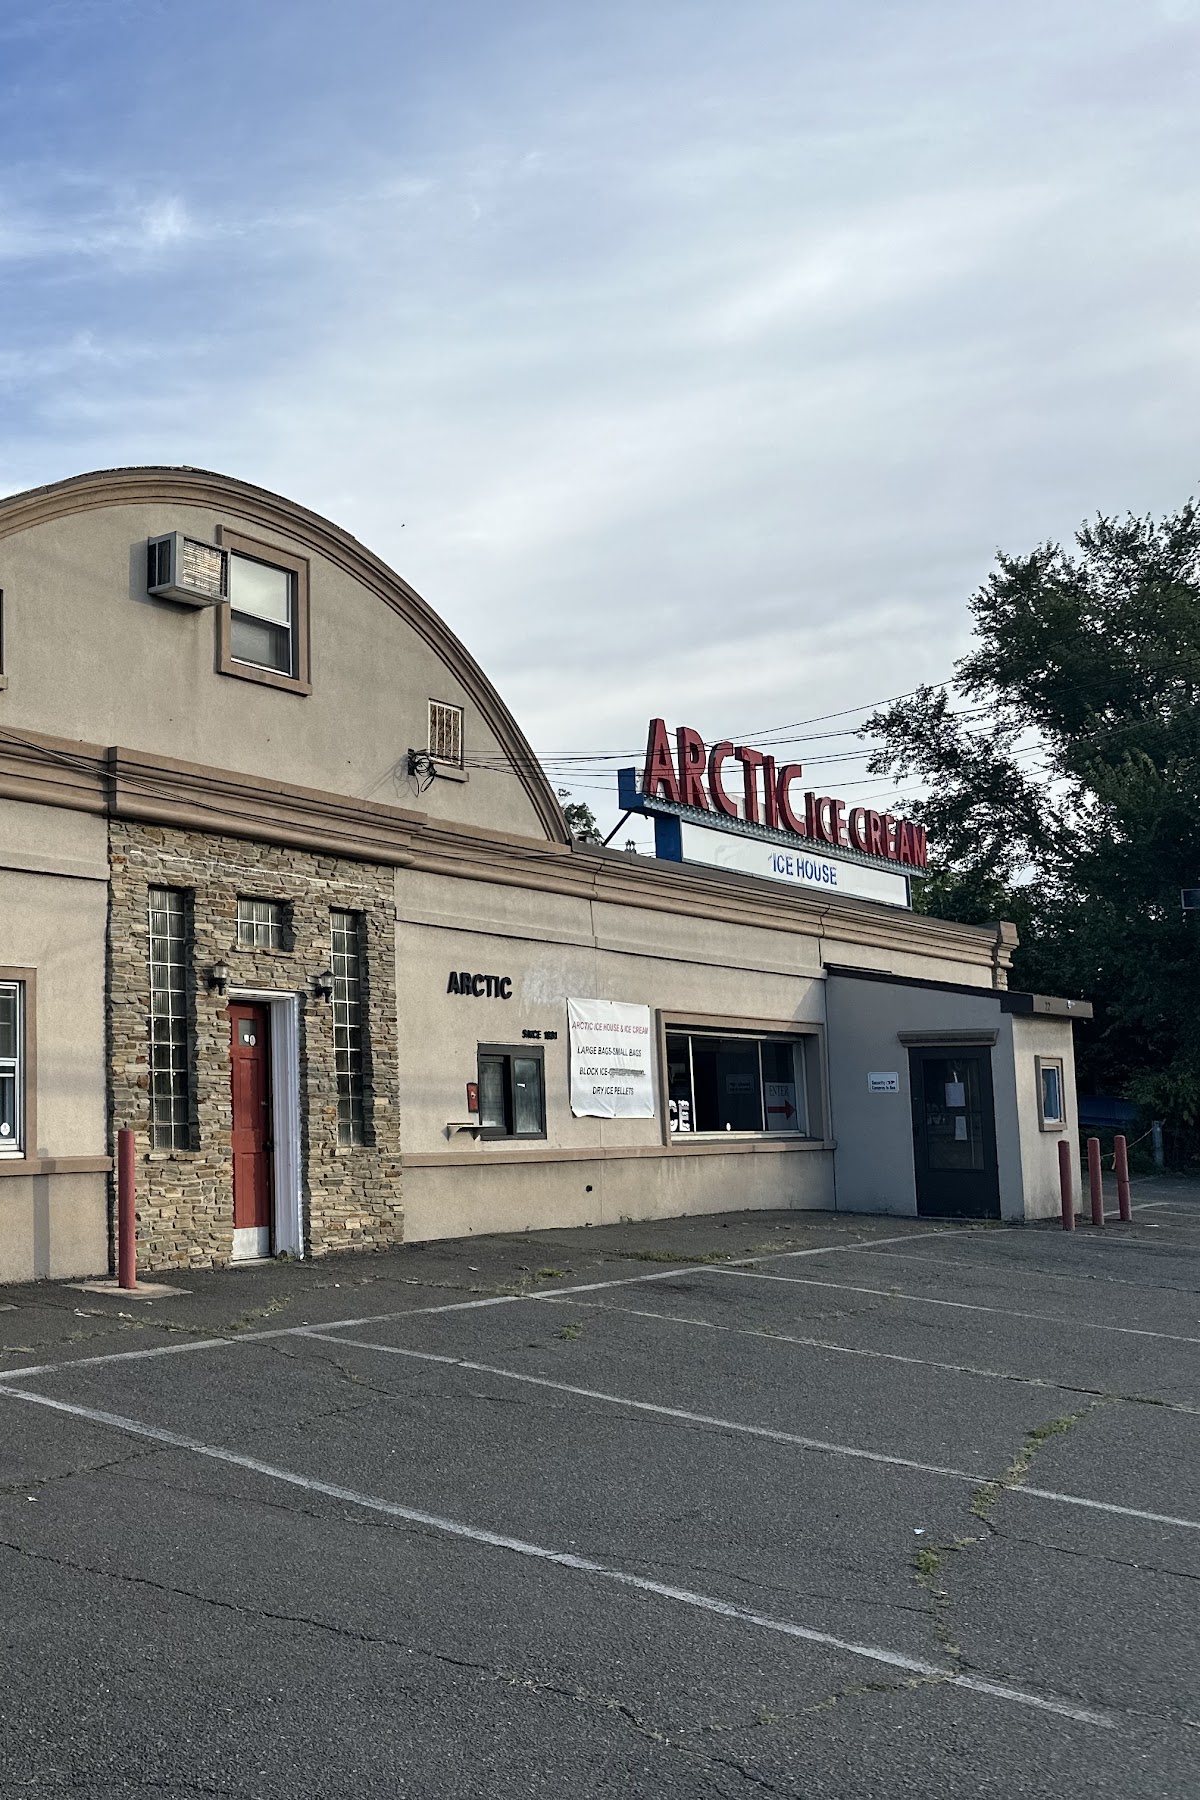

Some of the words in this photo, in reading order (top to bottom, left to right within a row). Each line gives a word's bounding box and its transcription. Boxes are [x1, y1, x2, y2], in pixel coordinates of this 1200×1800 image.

[643, 718, 806, 836] ARCTIC
[804, 791, 848, 847] ICE
[849, 807, 928, 868] CREAM
[772, 852, 794, 876] ICE
[796, 857, 838, 886] HOUSE
[446, 971, 513, 1000] ARCTIC
[521, 1029, 542, 1039] SINCE
[572, 1021, 594, 1031] ARCTIC
[594, 1022, 603, 1032] ICE
[603, 1023, 620, 1033] HOUSE
[624, 1025, 632, 1034] ICE
[632, 1025, 649, 1035] CREAM
[577, 1045, 597, 1055] LARGE
[628, 1048, 642, 1058] BAGS
[579, 1066, 599, 1076] BLOCK
[592, 1086, 604, 1095] DRY
[604, 1086, 614, 1095] ICE
[614, 1086, 634, 1096] PELLETS
[768, 1085, 790, 1098] ENTER
